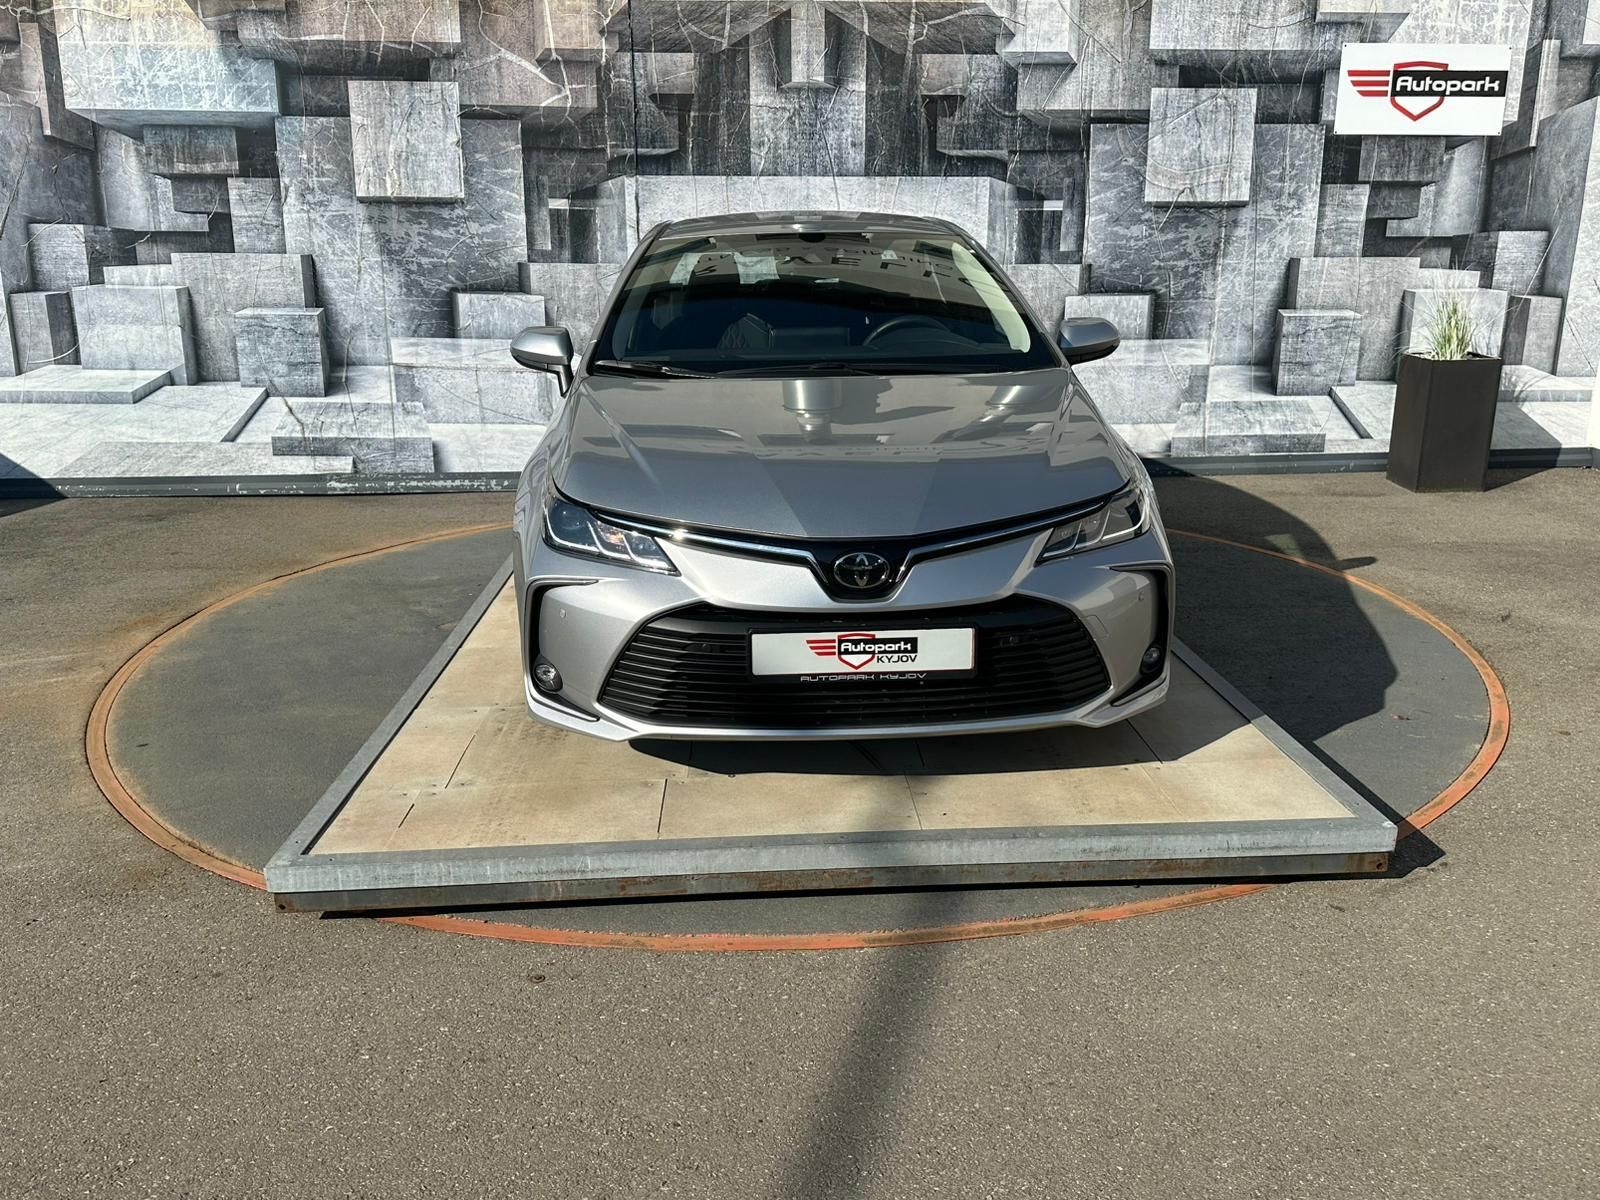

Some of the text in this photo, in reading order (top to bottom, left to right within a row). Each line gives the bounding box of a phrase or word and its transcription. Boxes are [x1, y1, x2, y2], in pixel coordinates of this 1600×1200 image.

[1395, 76, 1500, 96] Autopark
[840, 641, 912, 653] Autopark
[876, 654, 918, 664] KYJOV
[800, 672, 928, 682] AUTOPARK KYJOV
